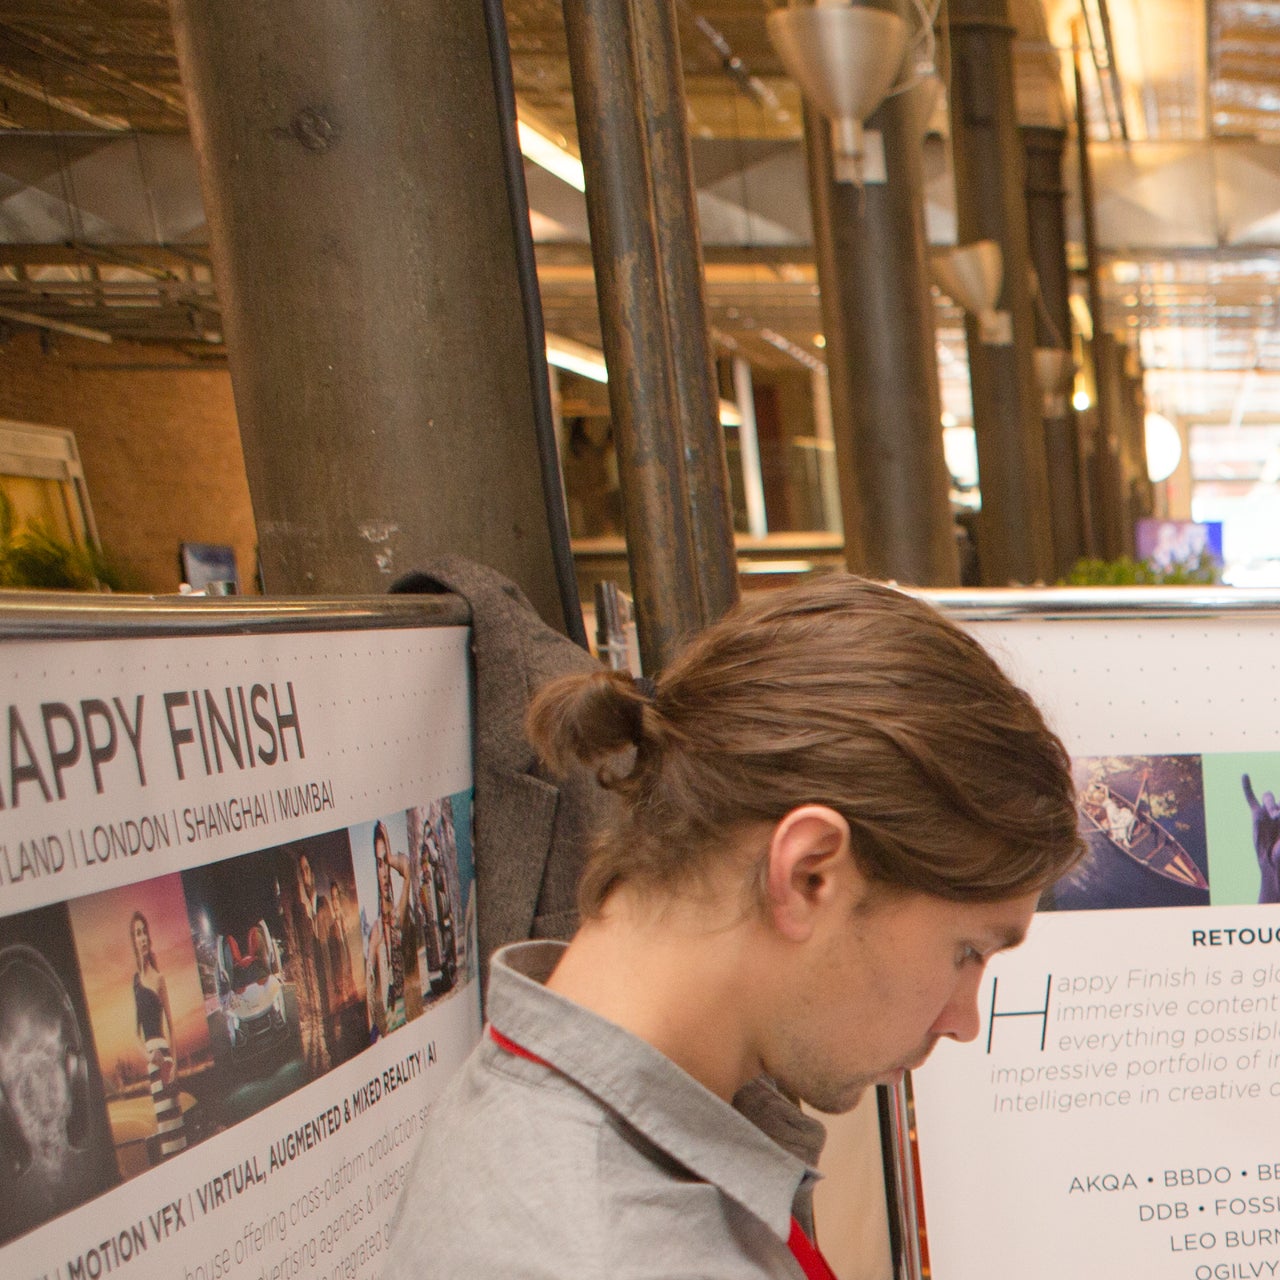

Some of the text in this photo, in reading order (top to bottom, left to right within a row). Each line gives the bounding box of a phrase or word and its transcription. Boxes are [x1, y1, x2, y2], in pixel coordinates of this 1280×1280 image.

[0, 680, 305, 811] APPY FINISH
[81, 780, 336, 865] LONDON SHANGHAI MUMBAI
[1057, 974, 1118, 995] appy
[1127, 966, 1195, 989] Finish
[1205, 969, 1221, 987] is
[1230, 969, 1243, 986] a
[1057, 999, 1178, 1021] immersive
[1186, 993, 1278, 1016] content
[1058, 1026, 1185, 1053] everything
[990, 1061, 1117, 1086] impressive
[1126, 1051, 1227, 1080] portfolio
[1236, 1048, 1260, 1071] of
[993, 1089, 1131, 1114] Intelligence
[1140, 1087, 1159, 1103] in
[1168, 1081, 1261, 1103] creative
[150, 1199, 187, 1245] VFX
[196, 1159, 268, 1216] VIRTUAL,
[268, 1098, 342, 1172] AUGMENTED
[352, 1076, 382, 1118] MIXED
[382, 1054, 423, 1099] REALITY
[1068, 1172, 1138, 1194] AKQA
[1163, 1165, 1232, 1188] BBDO
[1138, 1201, 1189, 1222] DDB
[1169, 1231, 1217, 1252] LEO
